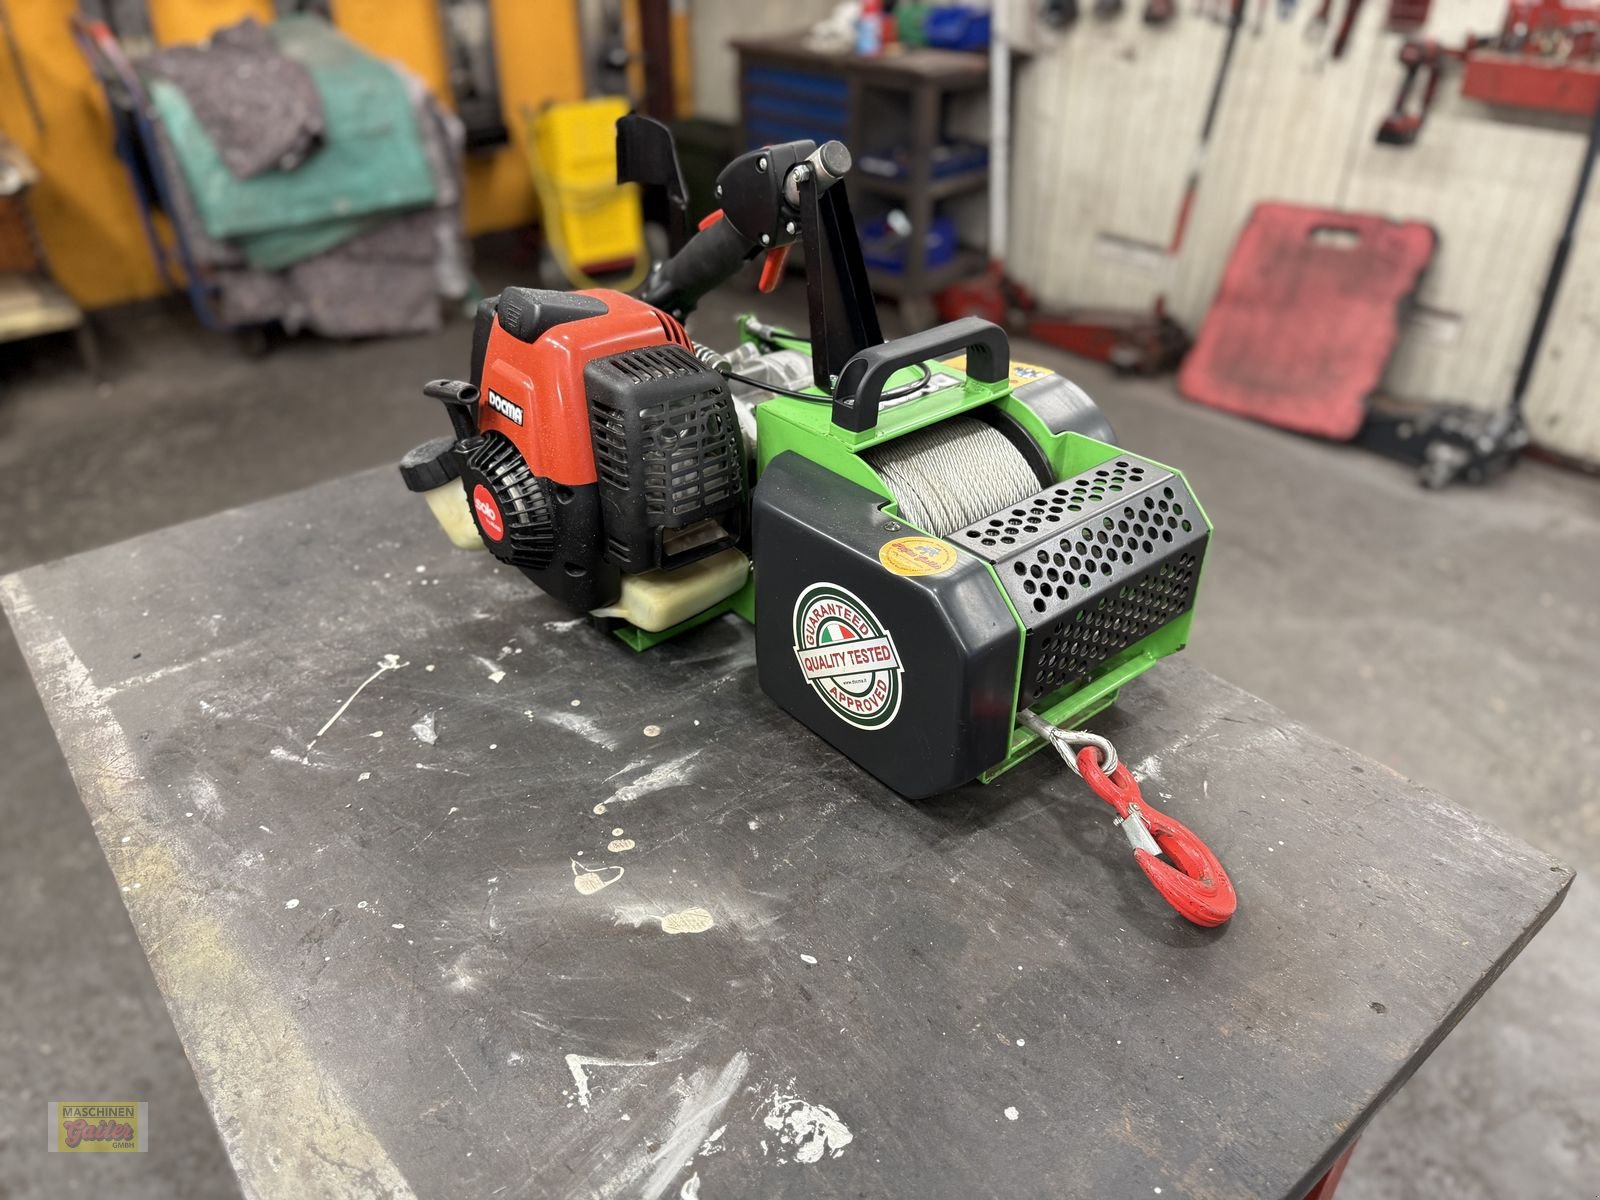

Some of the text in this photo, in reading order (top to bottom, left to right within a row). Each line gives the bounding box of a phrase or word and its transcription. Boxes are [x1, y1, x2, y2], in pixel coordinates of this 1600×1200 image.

[489, 390, 523, 426] DOCMA
[474, 498, 496, 521] solo
[805, 603, 869, 645] GUARANTEED
[804, 645, 891, 672] QUALITY TESTED
[829, 679, 887, 712] APPROVED
